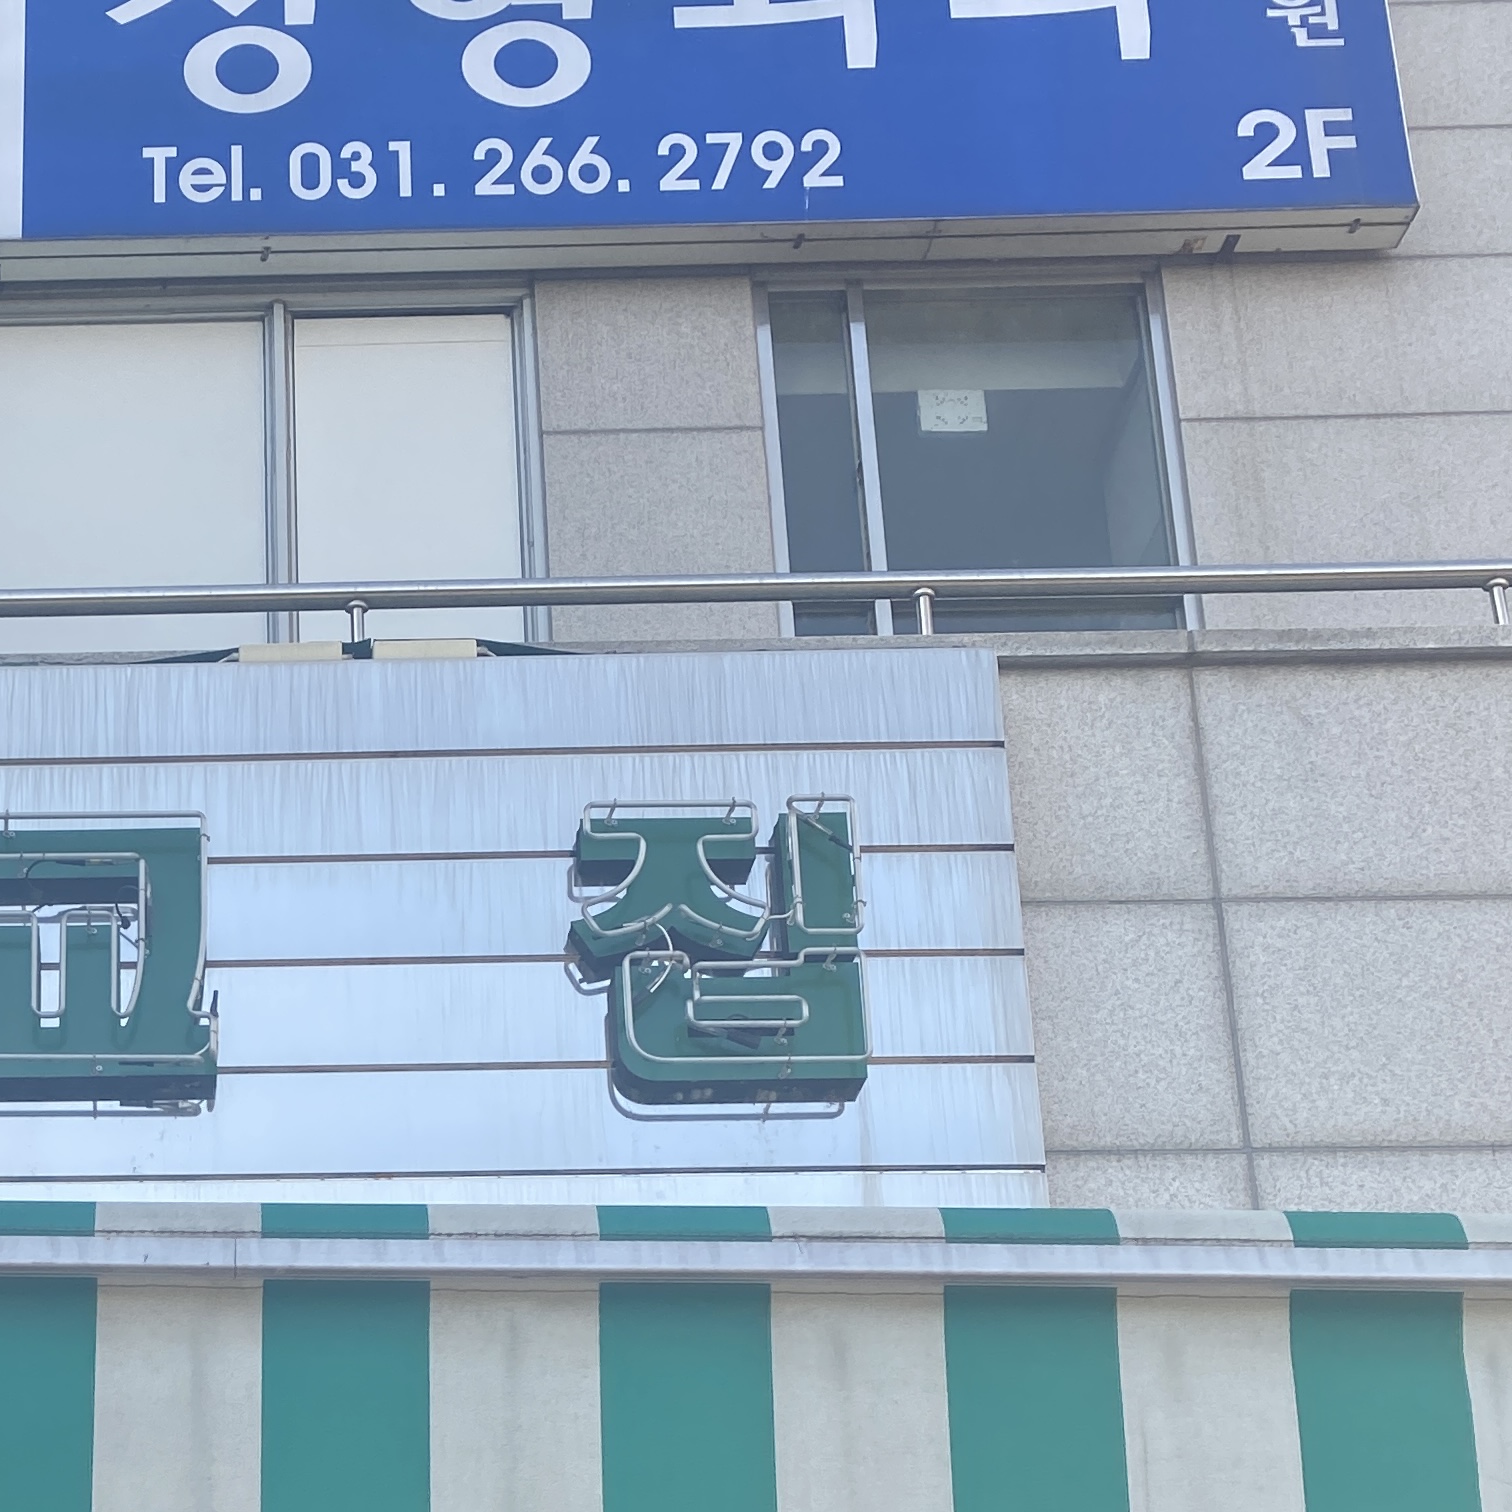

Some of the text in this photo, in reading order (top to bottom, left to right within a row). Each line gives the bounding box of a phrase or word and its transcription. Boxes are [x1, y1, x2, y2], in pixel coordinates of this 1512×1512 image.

[142, 128, 845, 203] Tel. 031. 266. 2792
[1237, 107, 1358, 180] 2F
